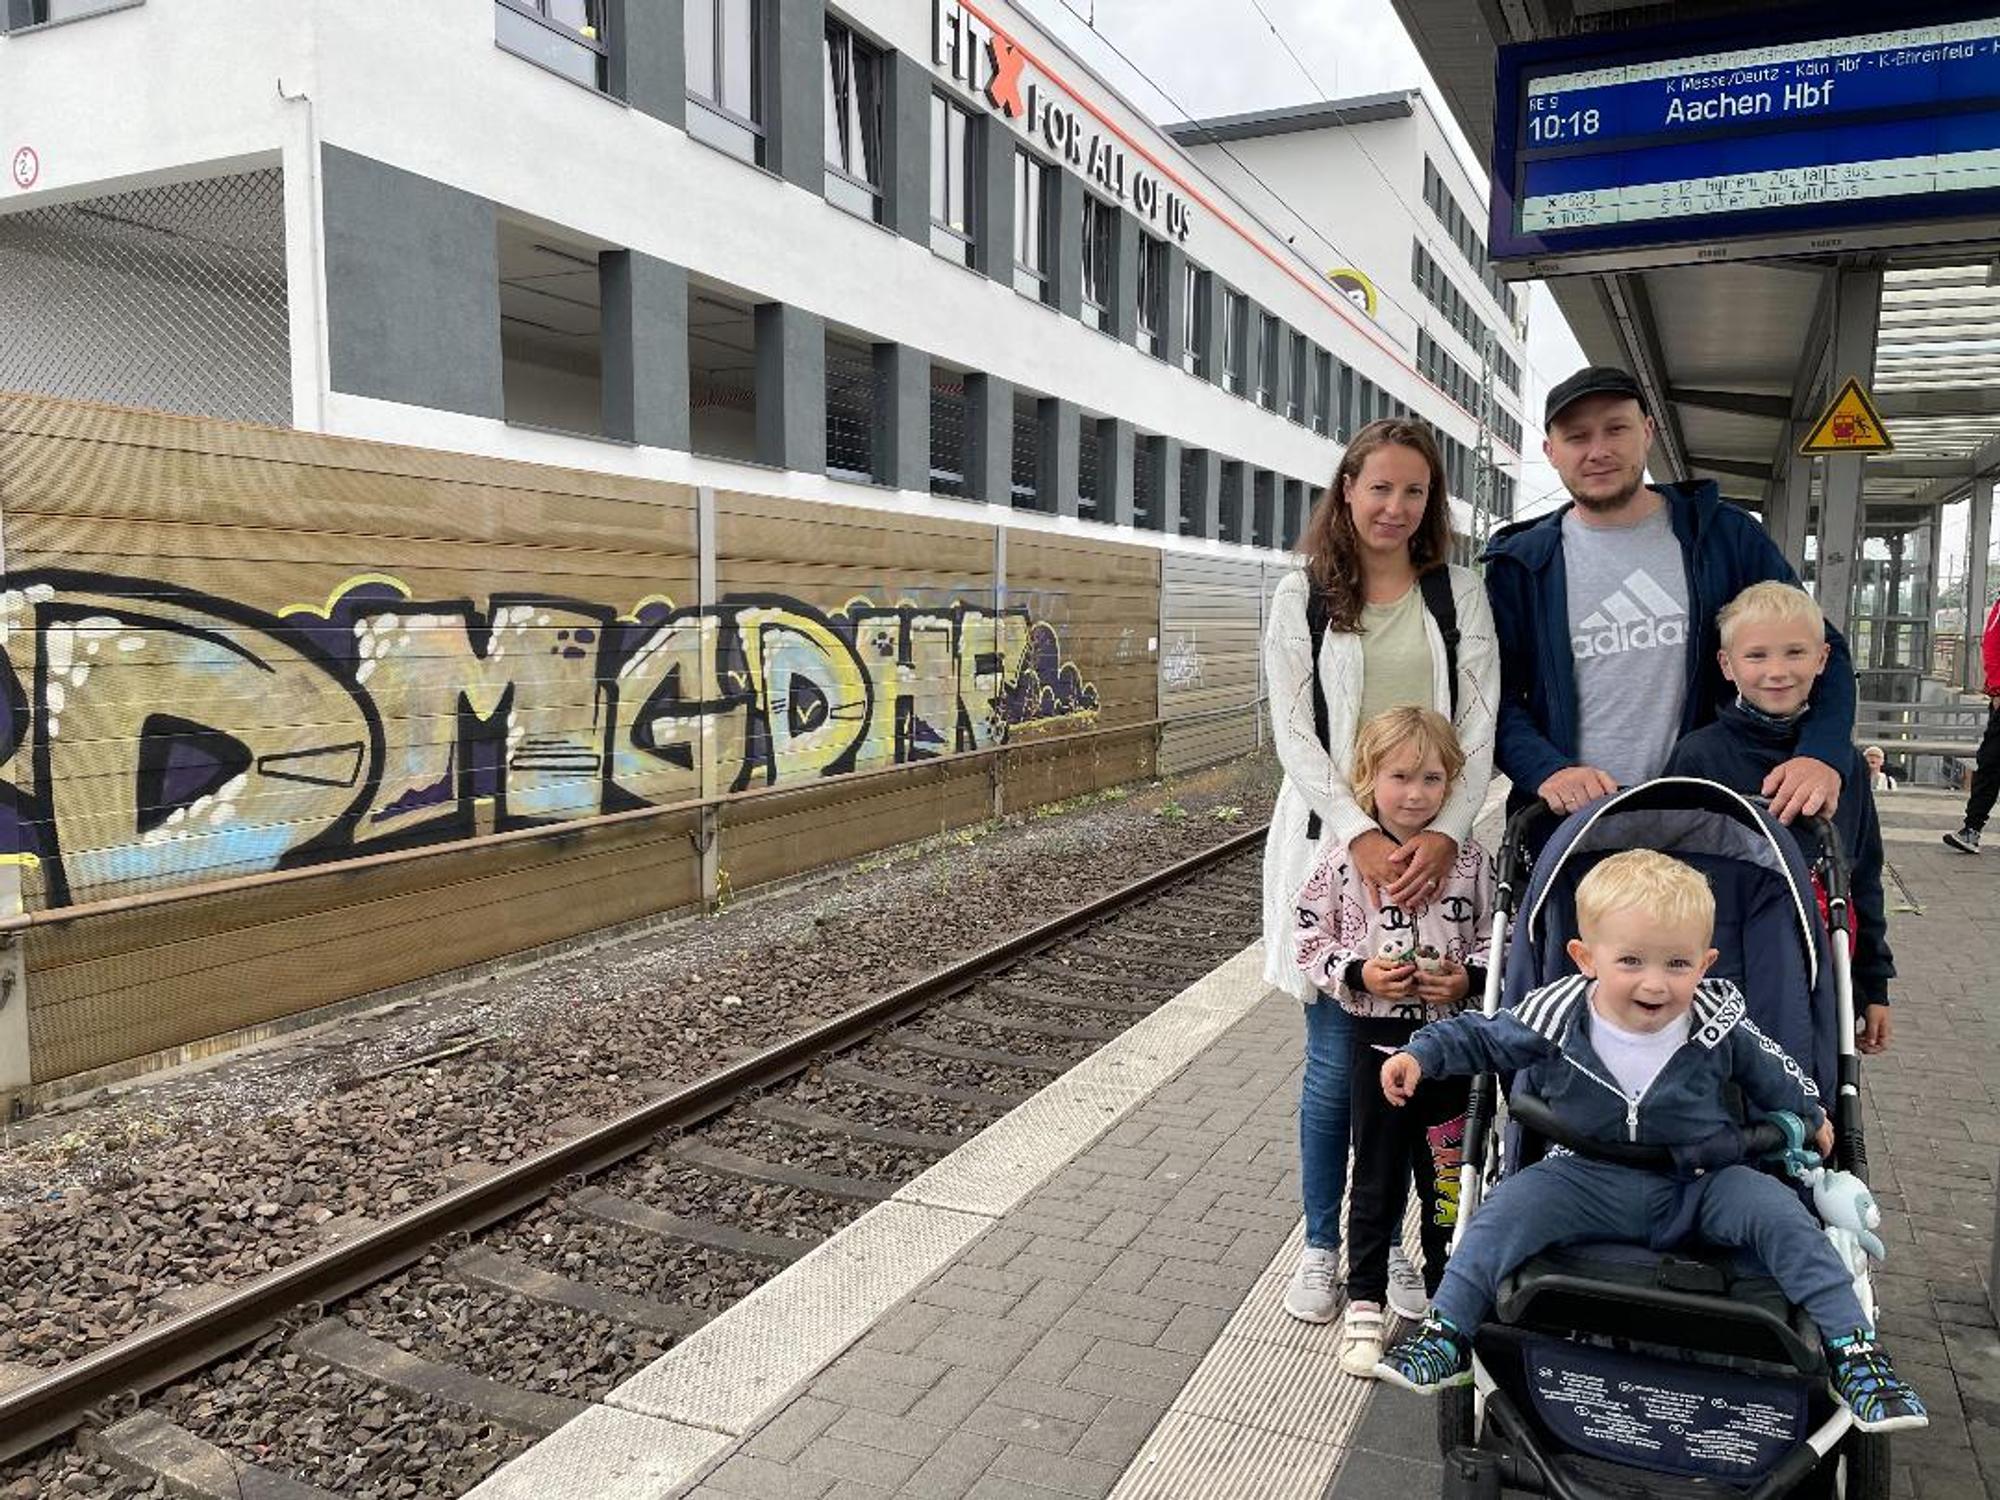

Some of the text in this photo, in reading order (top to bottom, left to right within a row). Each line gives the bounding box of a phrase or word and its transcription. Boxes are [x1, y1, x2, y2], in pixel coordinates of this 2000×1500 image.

[1666, 80, 1676, 95] K
[1681, 67, 1779, 93] Messe/Deutz
[1796, 61, 1830, 77] Köln
[1835, 57, 1862, 73] Hbf
[1879, 43, 1974, 68] K-Ehrenfeld
[1529, 96, 1559, 112] RE 9
[1665, 80, 1835, 125] Aachen Hbf
[1529, 109, 1600, 142] 10:18
[1028, 84, 1082, 165] FOR
[1087, 135, 1130, 199] ALL
[1134, 172, 1164, 220] OF
[1167, 193, 1192, 242] US
[1571, 614, 1689, 659] adida
